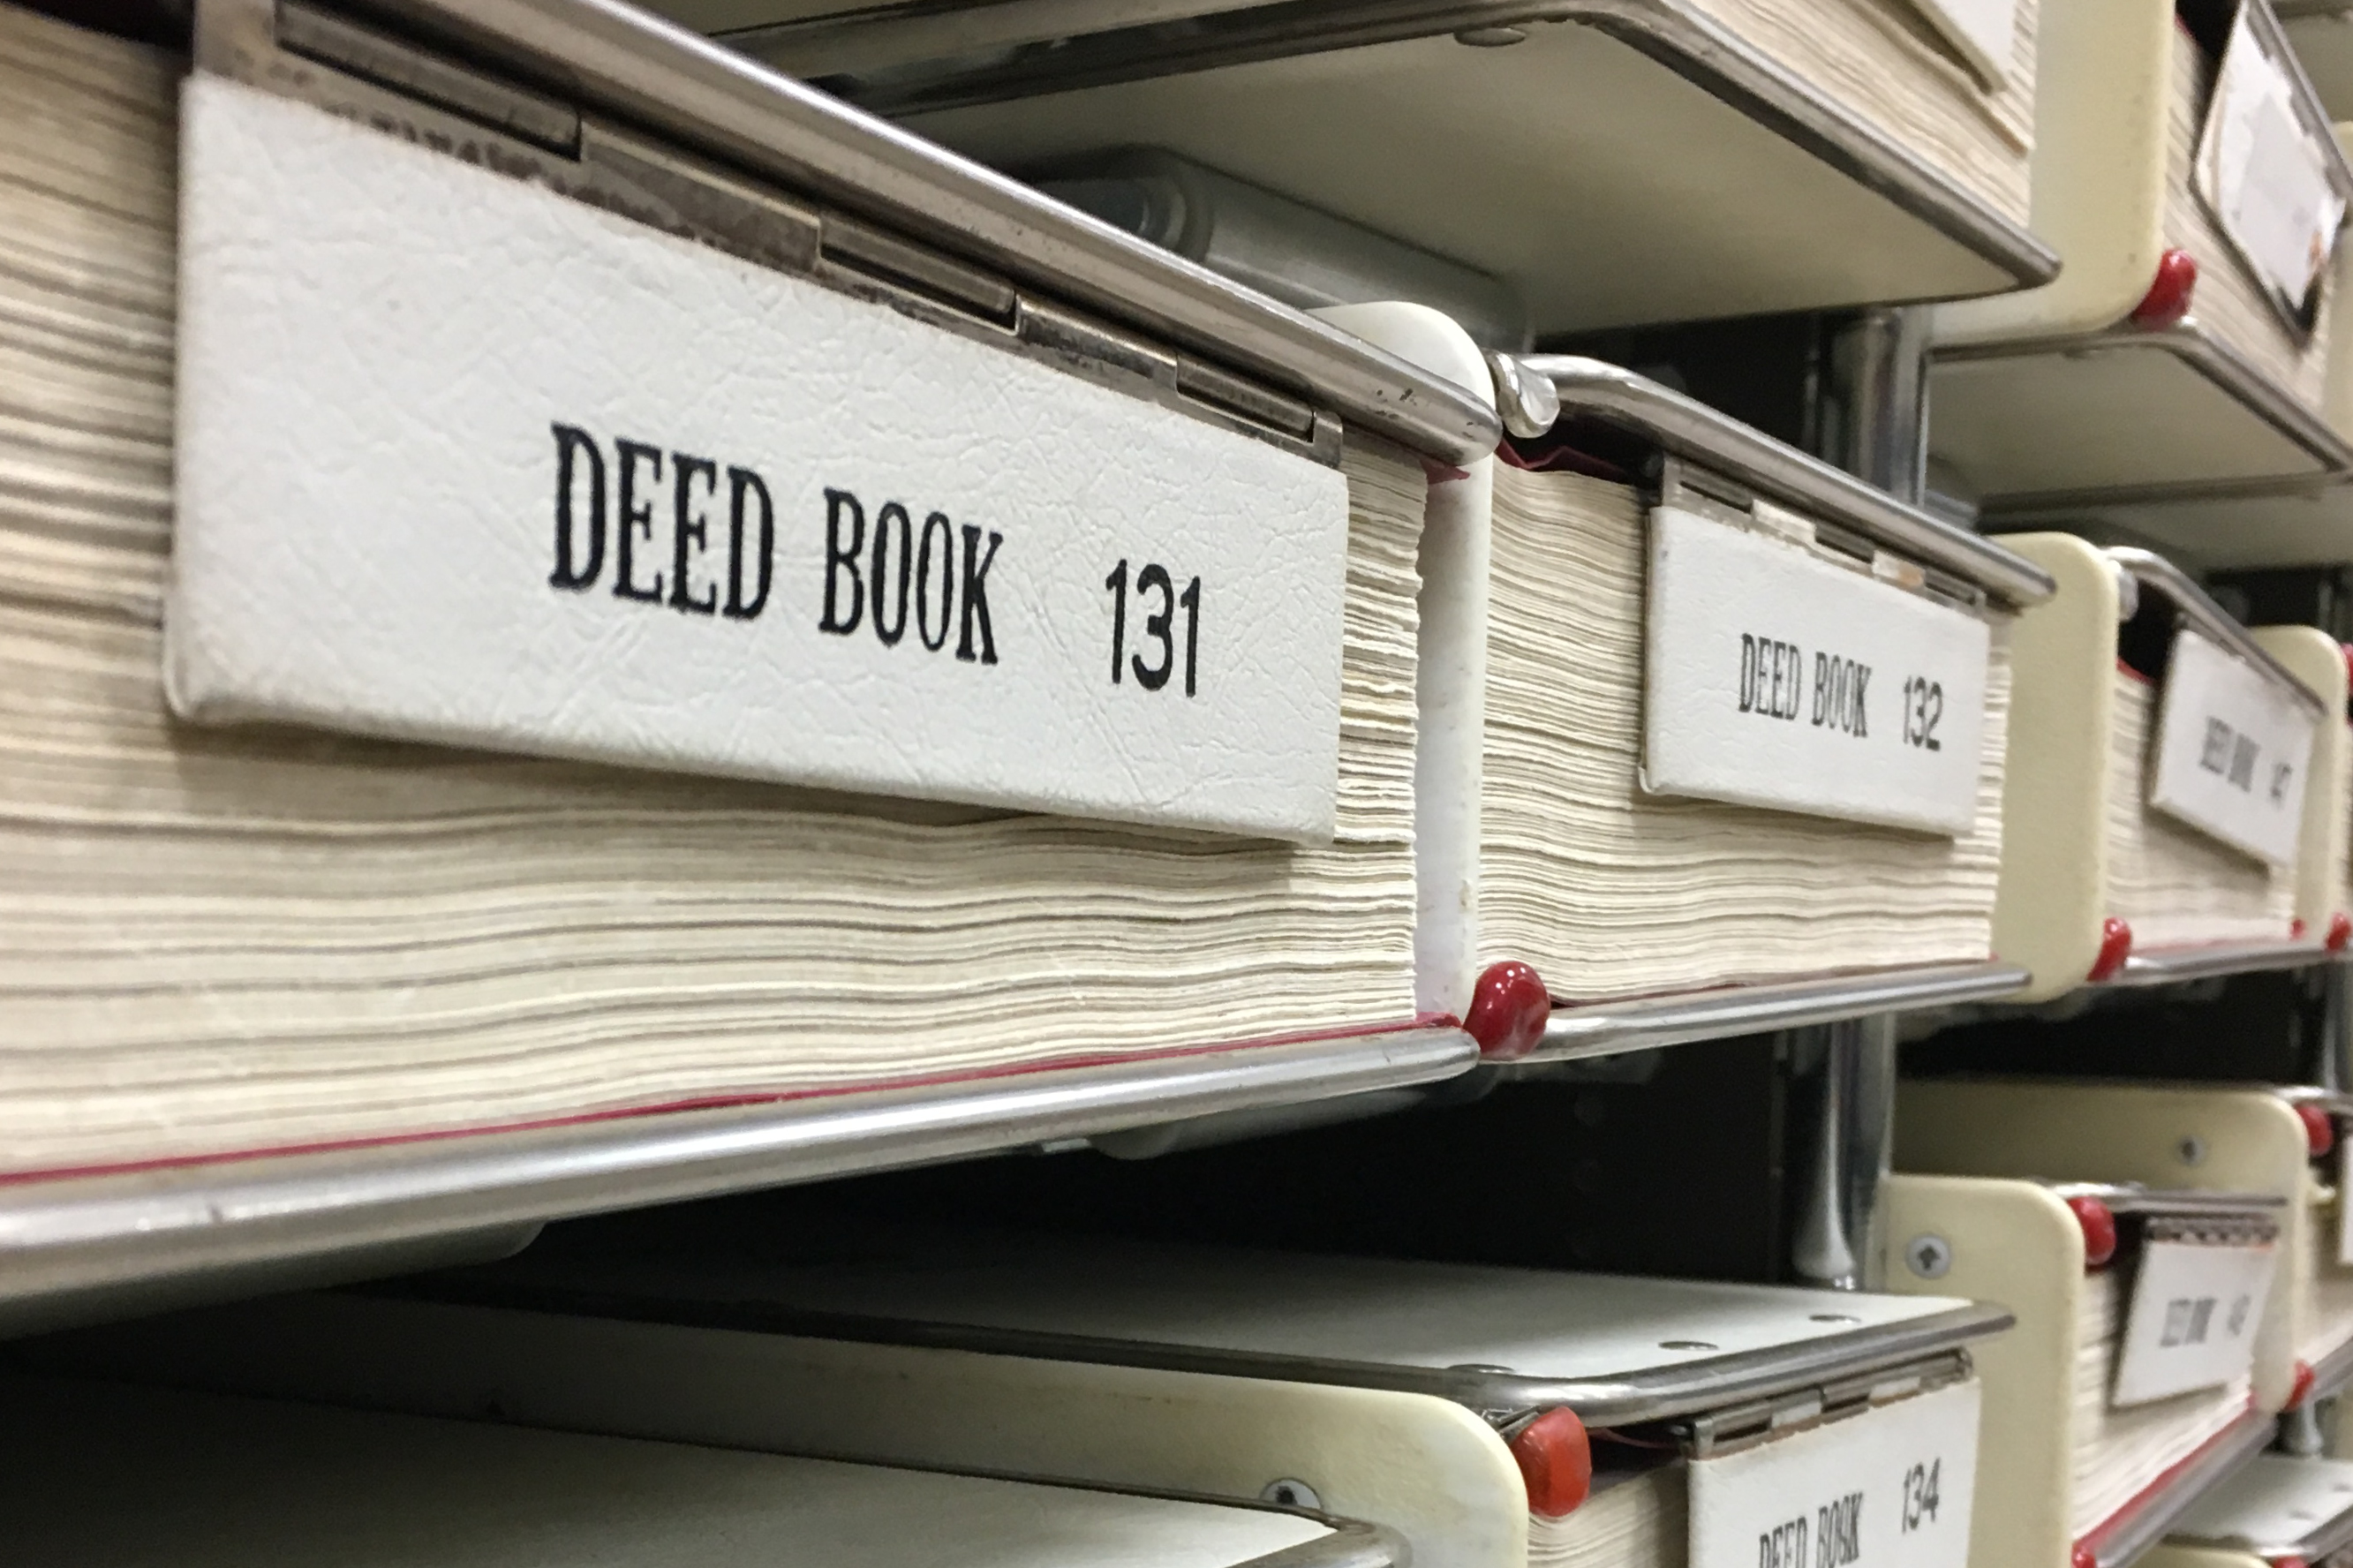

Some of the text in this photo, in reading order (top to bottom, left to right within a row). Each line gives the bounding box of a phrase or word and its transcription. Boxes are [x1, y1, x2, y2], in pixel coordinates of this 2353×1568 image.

[549, 422, 1201, 697] DEED BOOK 131
[1738, 633, 1943, 750] DEED BOOK 132
[1902, 1457, 1942, 1534] 134
